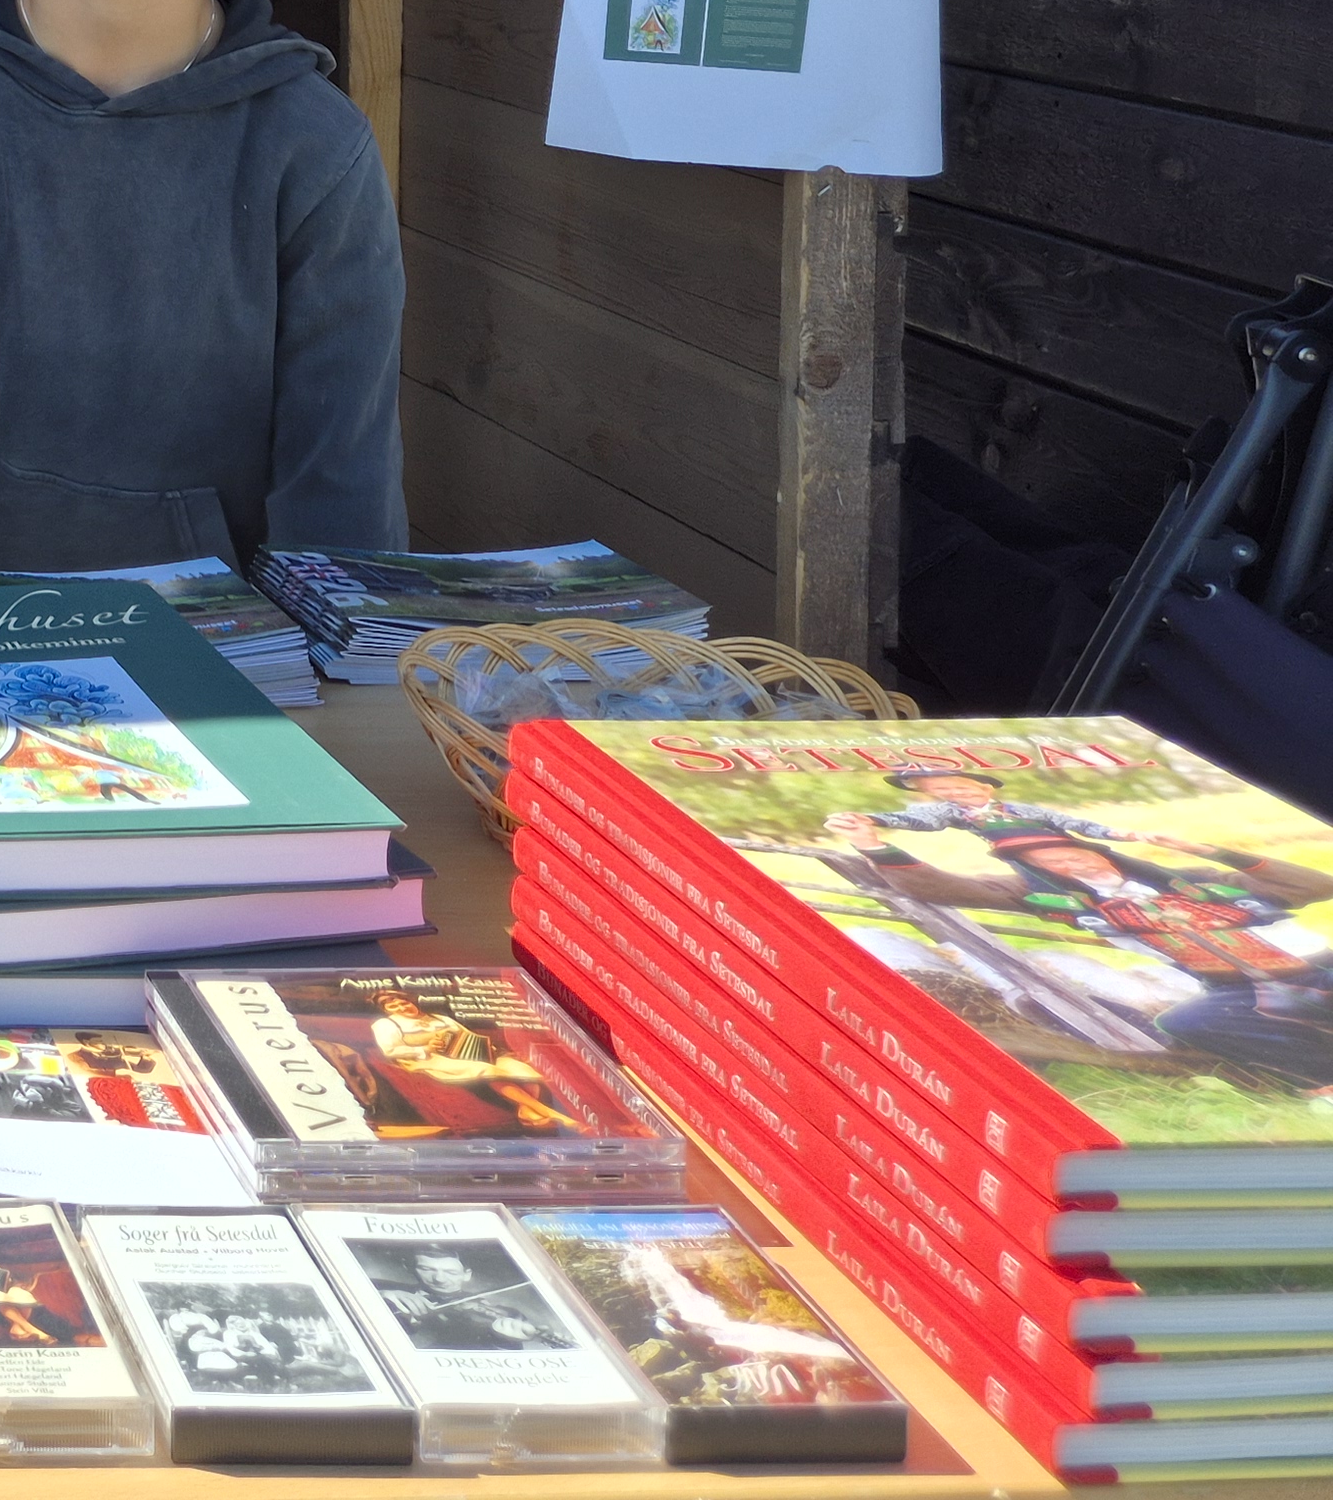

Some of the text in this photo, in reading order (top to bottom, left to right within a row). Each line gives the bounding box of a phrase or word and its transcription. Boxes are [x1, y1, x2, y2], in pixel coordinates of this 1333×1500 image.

[649, 734, 1159, 774] SETESDAL
[340, 975, 394, 990] Anne
[395, 975, 453, 988] Karin
[226, 983, 347, 1133] Venerus
[119, 1223, 278, 1246] Soger frå Setesdal
[362, 1216, 459, 1235] Fosslien
